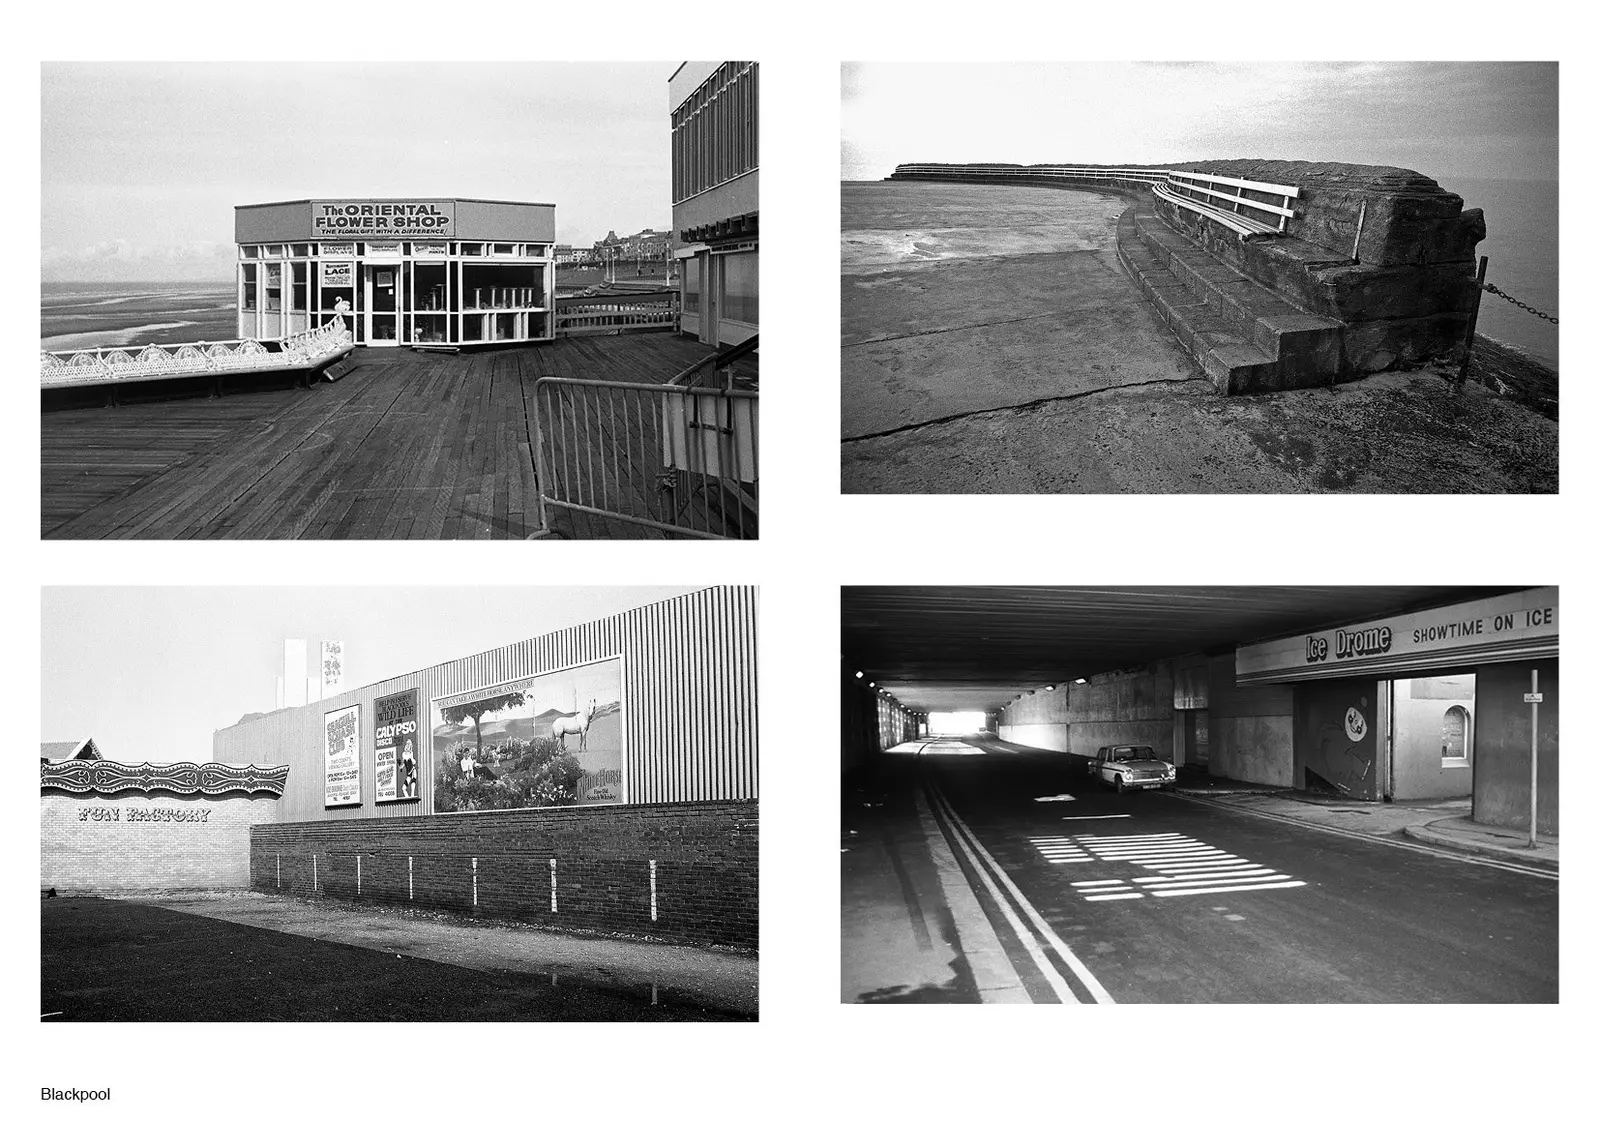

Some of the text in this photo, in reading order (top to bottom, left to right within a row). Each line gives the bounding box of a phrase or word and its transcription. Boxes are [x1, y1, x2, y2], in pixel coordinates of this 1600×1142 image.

[322, 204, 441, 216] The ORIENTAL
[315, 216, 450, 228] FLOWER SHOP
[325, 267, 350, 276] LACE
[1413, 608, 1552, 643] SHOWTIME ON ICE
[1306, 626, 1392, 662] Ice Drome
[378, 706, 414, 722] WILD LIFE
[376, 720, 417, 739] CALYPSO
[376, 737, 393, 747] DISCO
[378, 751, 394, 761] OPEN
[78, 807, 212, 822] FUN FACTORY
